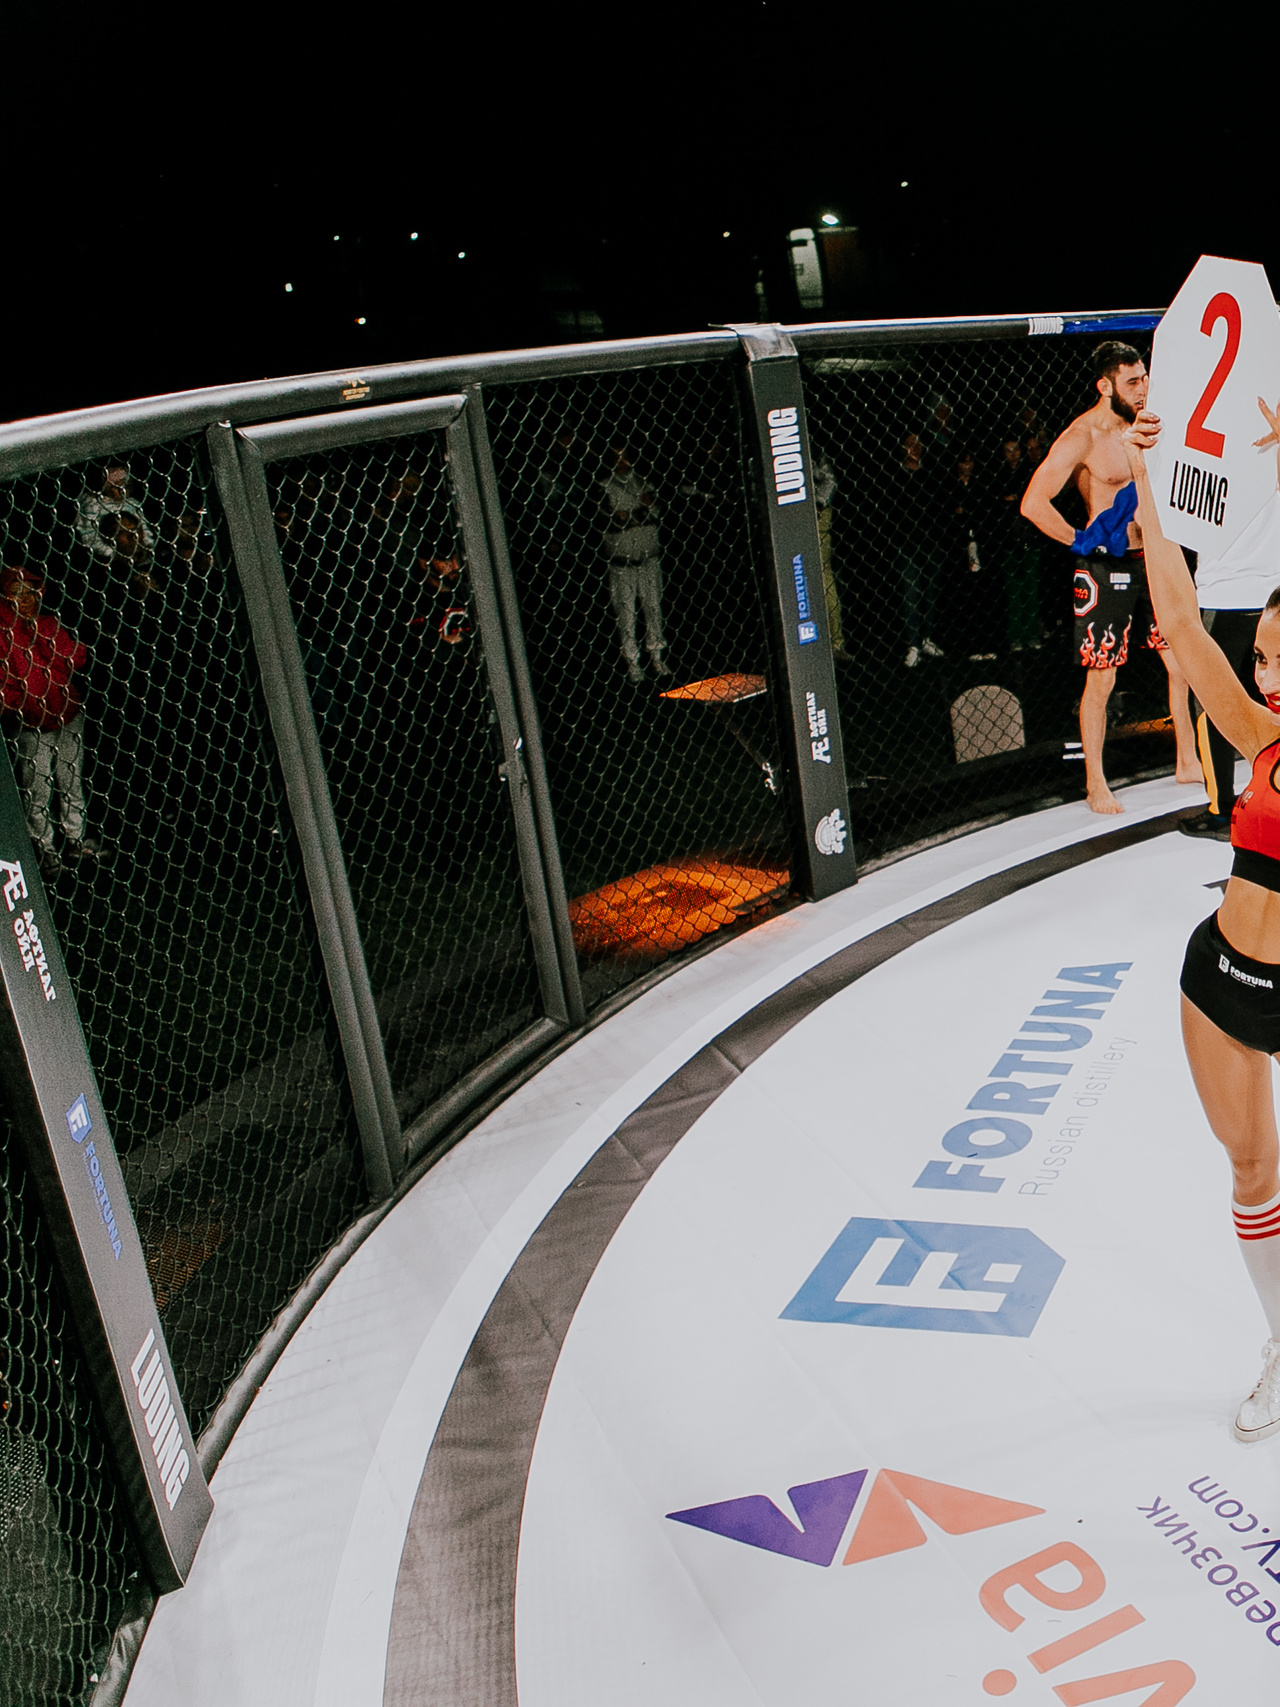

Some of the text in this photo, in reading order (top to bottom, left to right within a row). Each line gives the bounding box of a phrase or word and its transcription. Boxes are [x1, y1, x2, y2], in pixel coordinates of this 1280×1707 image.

[1185, 292, 1242, 459] 2
[767, 407, 807, 505] LUDING
[1170, 461, 1228, 527] LUDING
[793, 553, 808, 619] FORTUNA
[1230, 966, 1274, 989] FORTUNA
[911, 962, 1134, 1194] FORTUNA
[1018, 1036, 1139, 1196] Russian distillery
[85, 1140, 123, 1261] FORTUNA
[130, 1328, 190, 1511] LUDING
